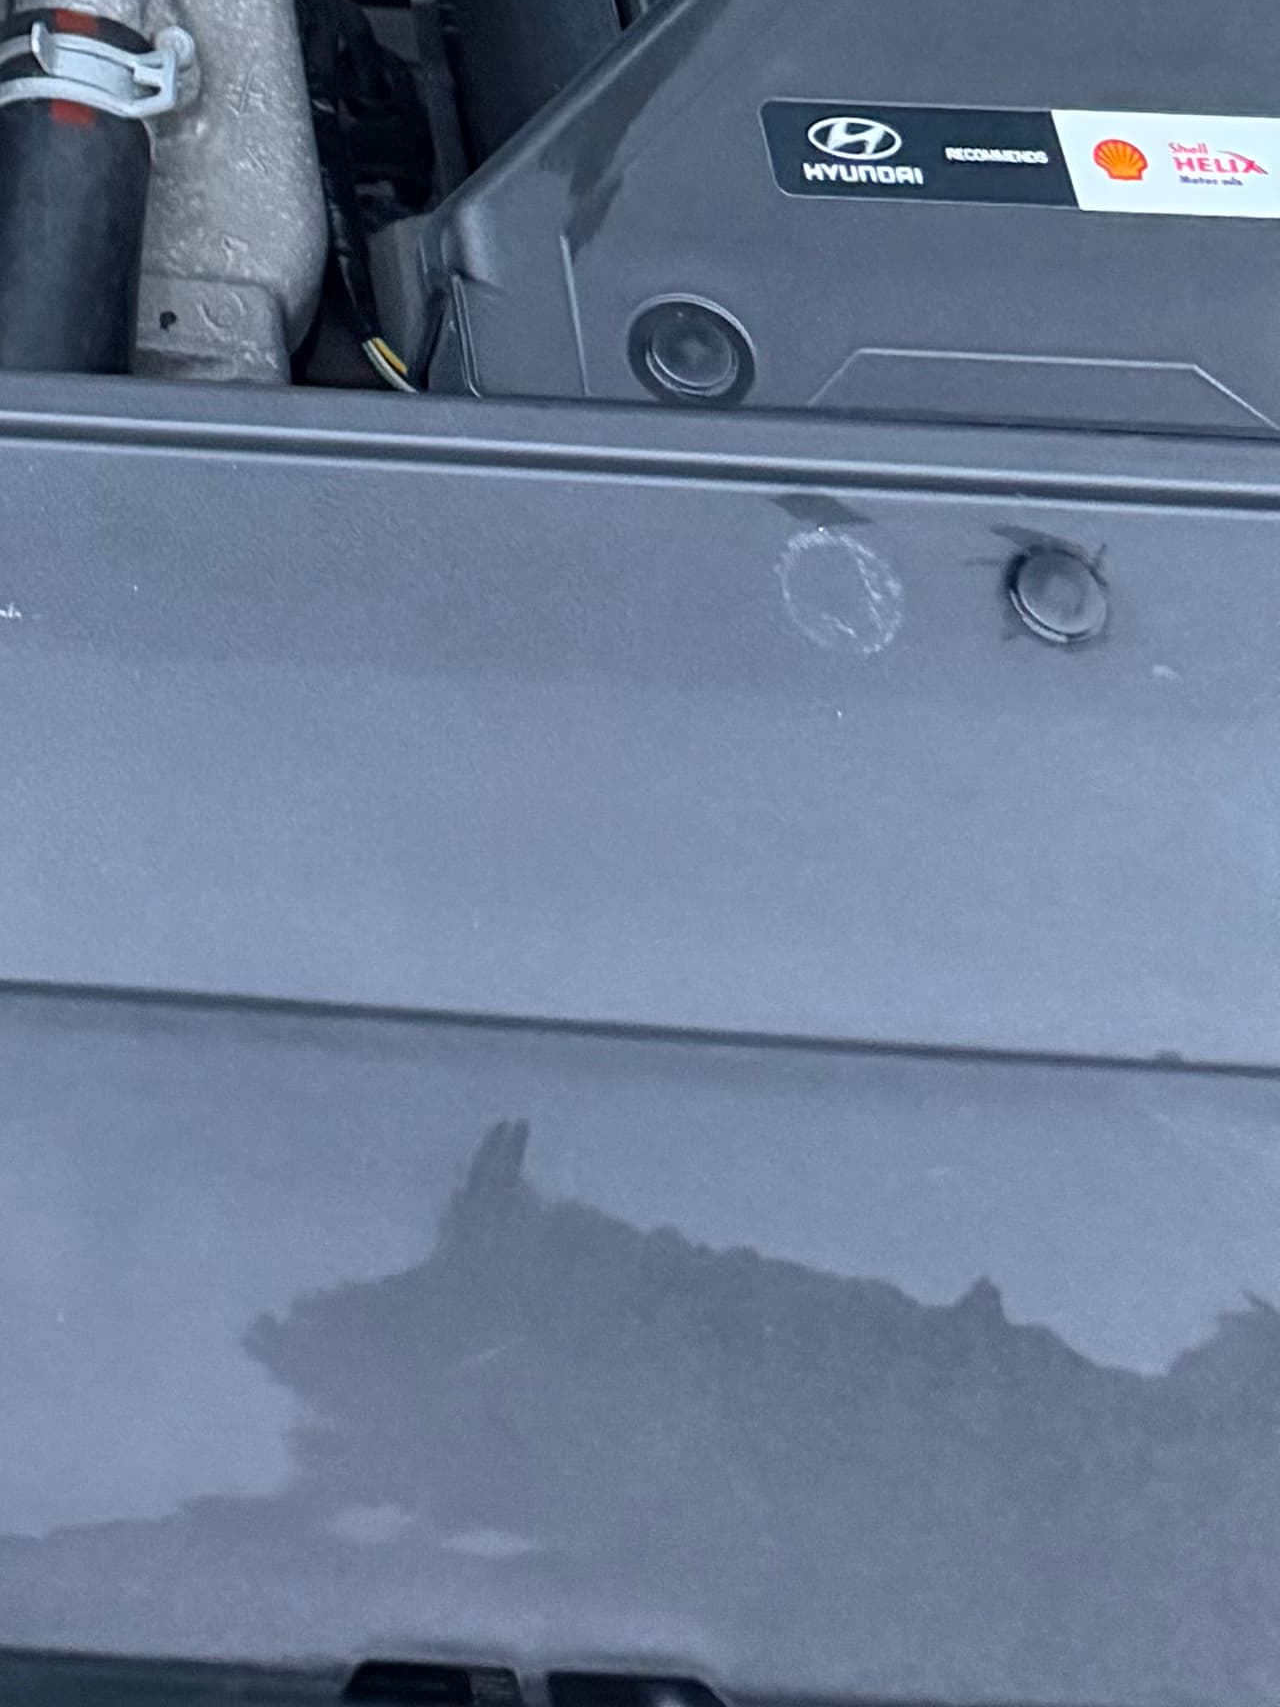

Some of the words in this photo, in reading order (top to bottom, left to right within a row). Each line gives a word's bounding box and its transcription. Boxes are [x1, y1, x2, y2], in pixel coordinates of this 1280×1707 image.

[944, 146, 1049, 165] RECOMMENDS
[1168, 142, 1208, 155] Shell
[801, 161, 924, 186] HYUNDAI
[1172, 153, 1269, 175] HELIX
